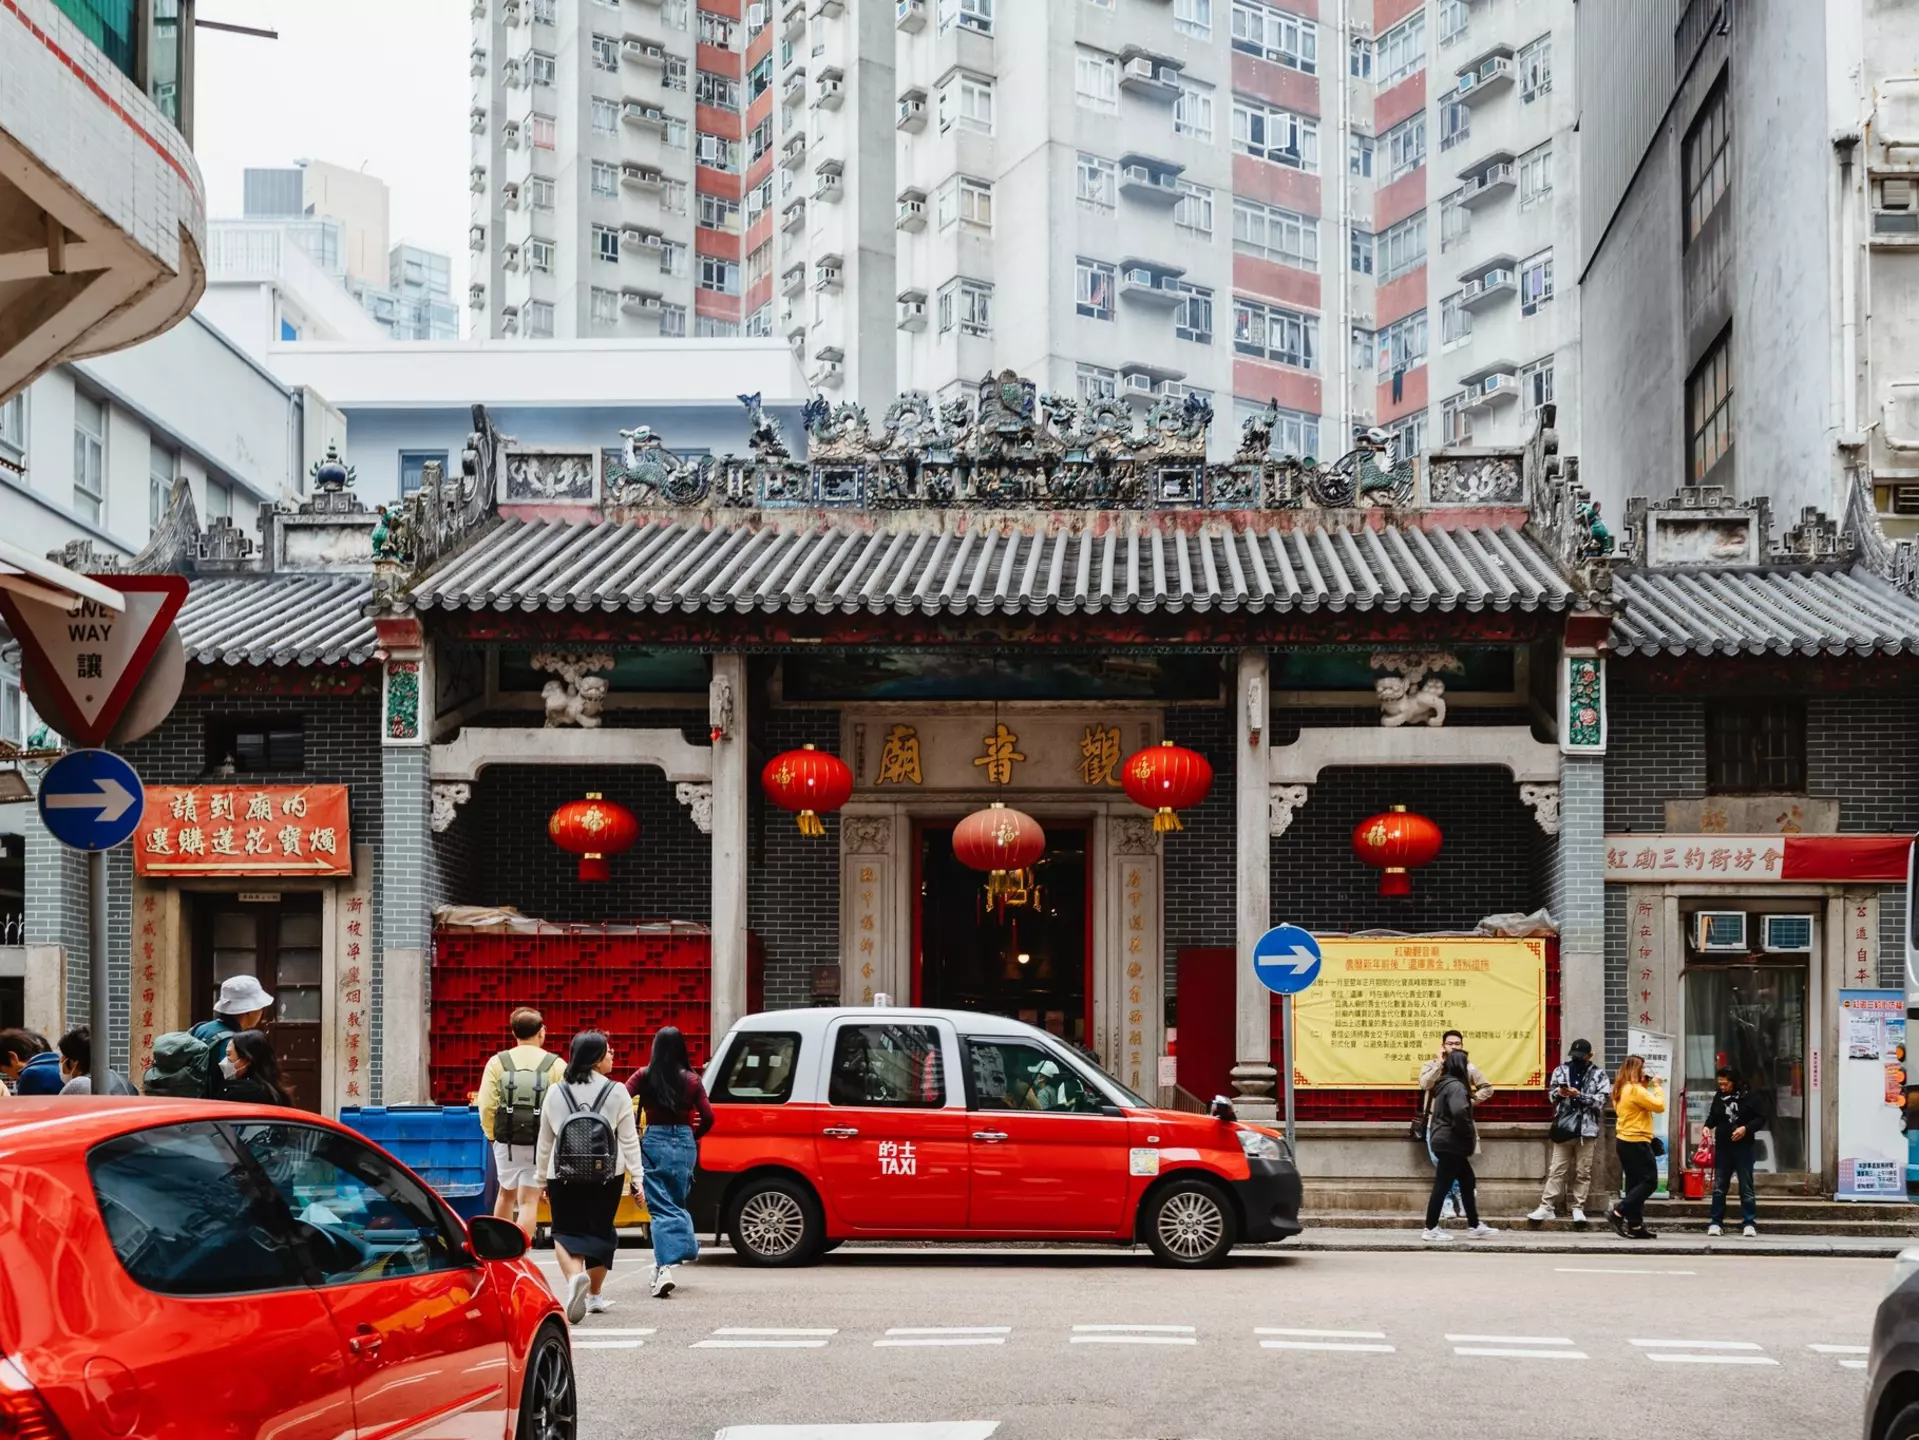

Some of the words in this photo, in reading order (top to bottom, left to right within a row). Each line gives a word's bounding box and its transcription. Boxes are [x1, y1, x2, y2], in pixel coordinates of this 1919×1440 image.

[68, 624, 112, 642] WAY
[77, 652, 102, 679] 讓
[168, 791, 307, 823] 請到廟內
[146, 826, 337, 857] 選購蓮花寶燭
[1607, 846, 1783, 872] 紅磡三約街坊會
[878, 1141, 916, 1157] 的士
[878, 1158, 916, 1175] TAXI
